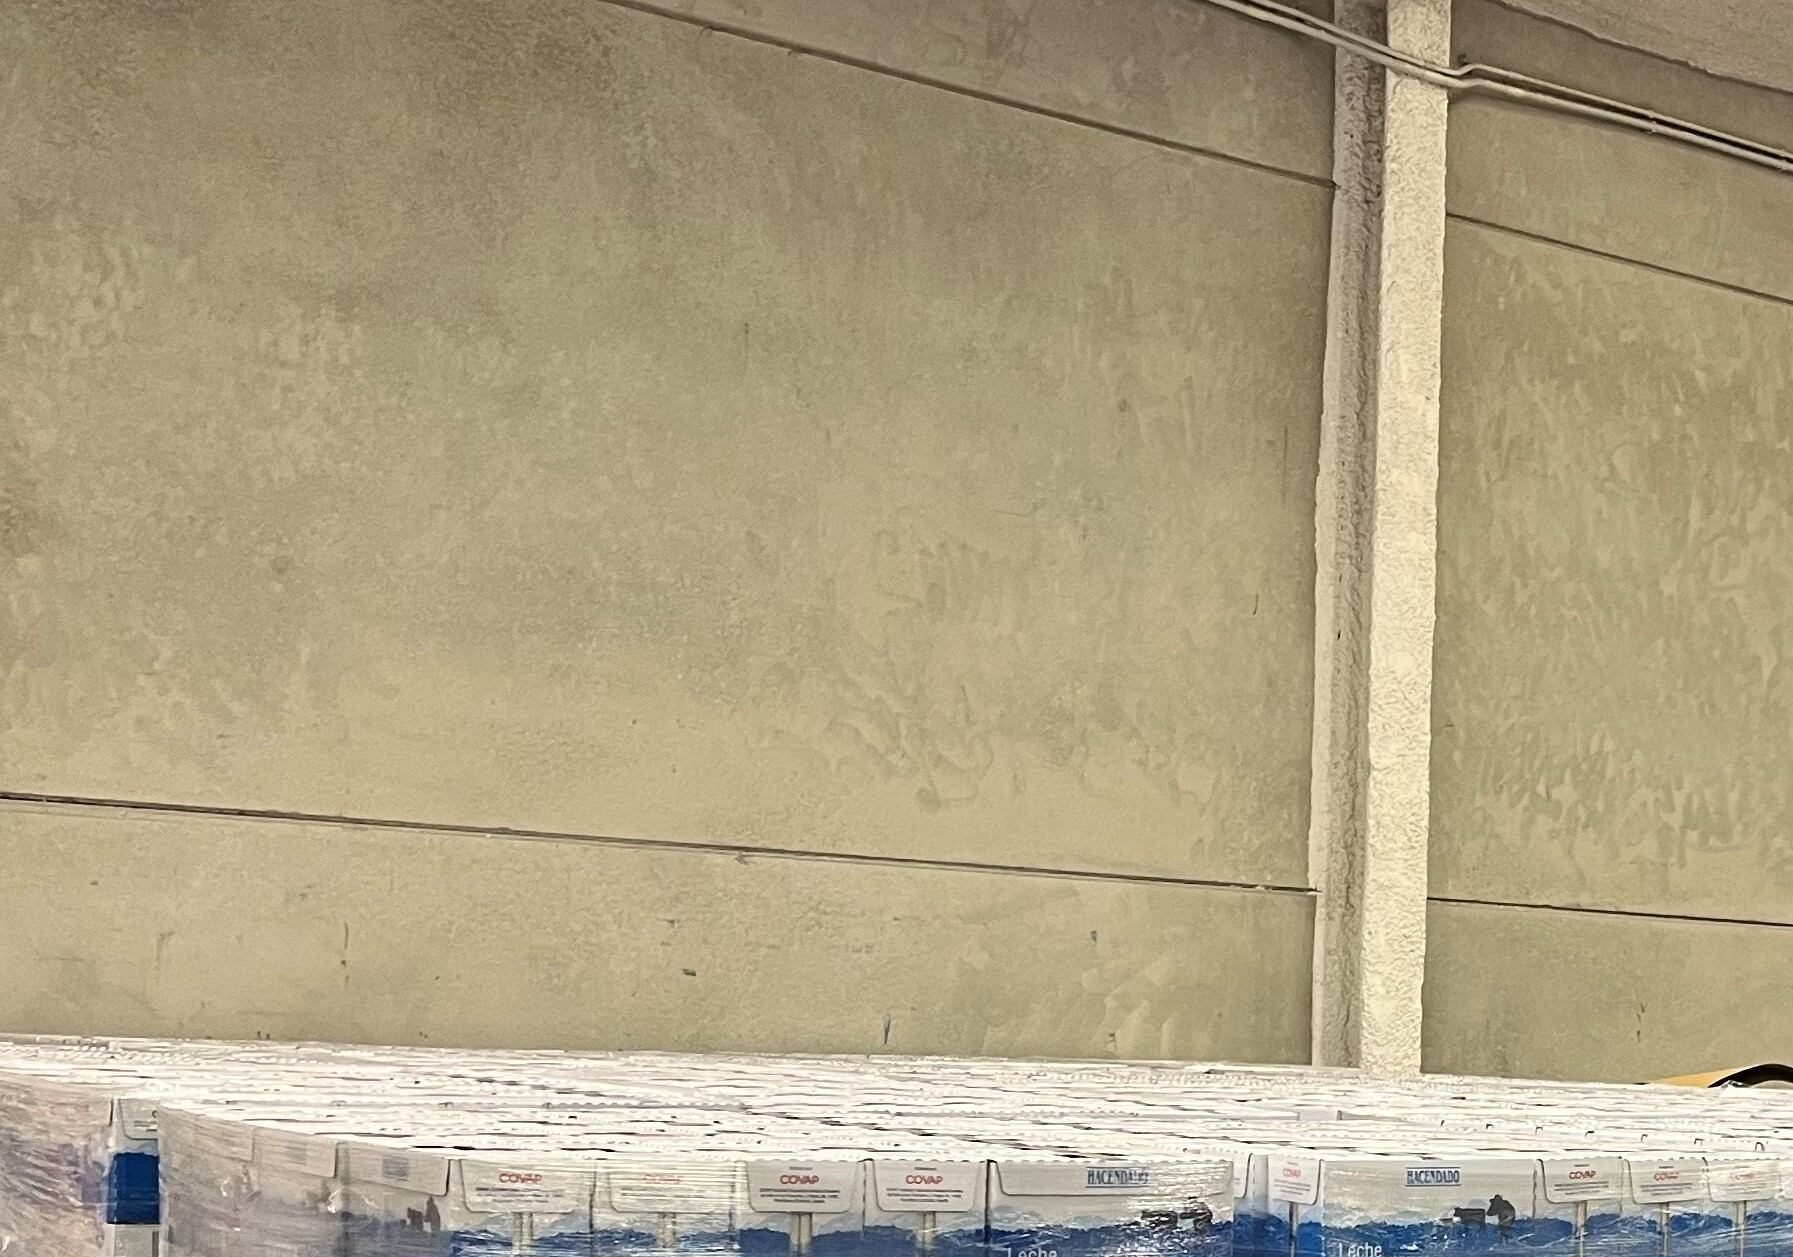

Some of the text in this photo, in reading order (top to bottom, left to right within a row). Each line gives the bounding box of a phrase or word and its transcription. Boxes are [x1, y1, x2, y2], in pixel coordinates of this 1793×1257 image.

[906, 1174, 943, 1184] COVAP
[1407, 1169, 1460, 1184] HACENDADO
[1569, 1170, 1596, 1180] COVAP
